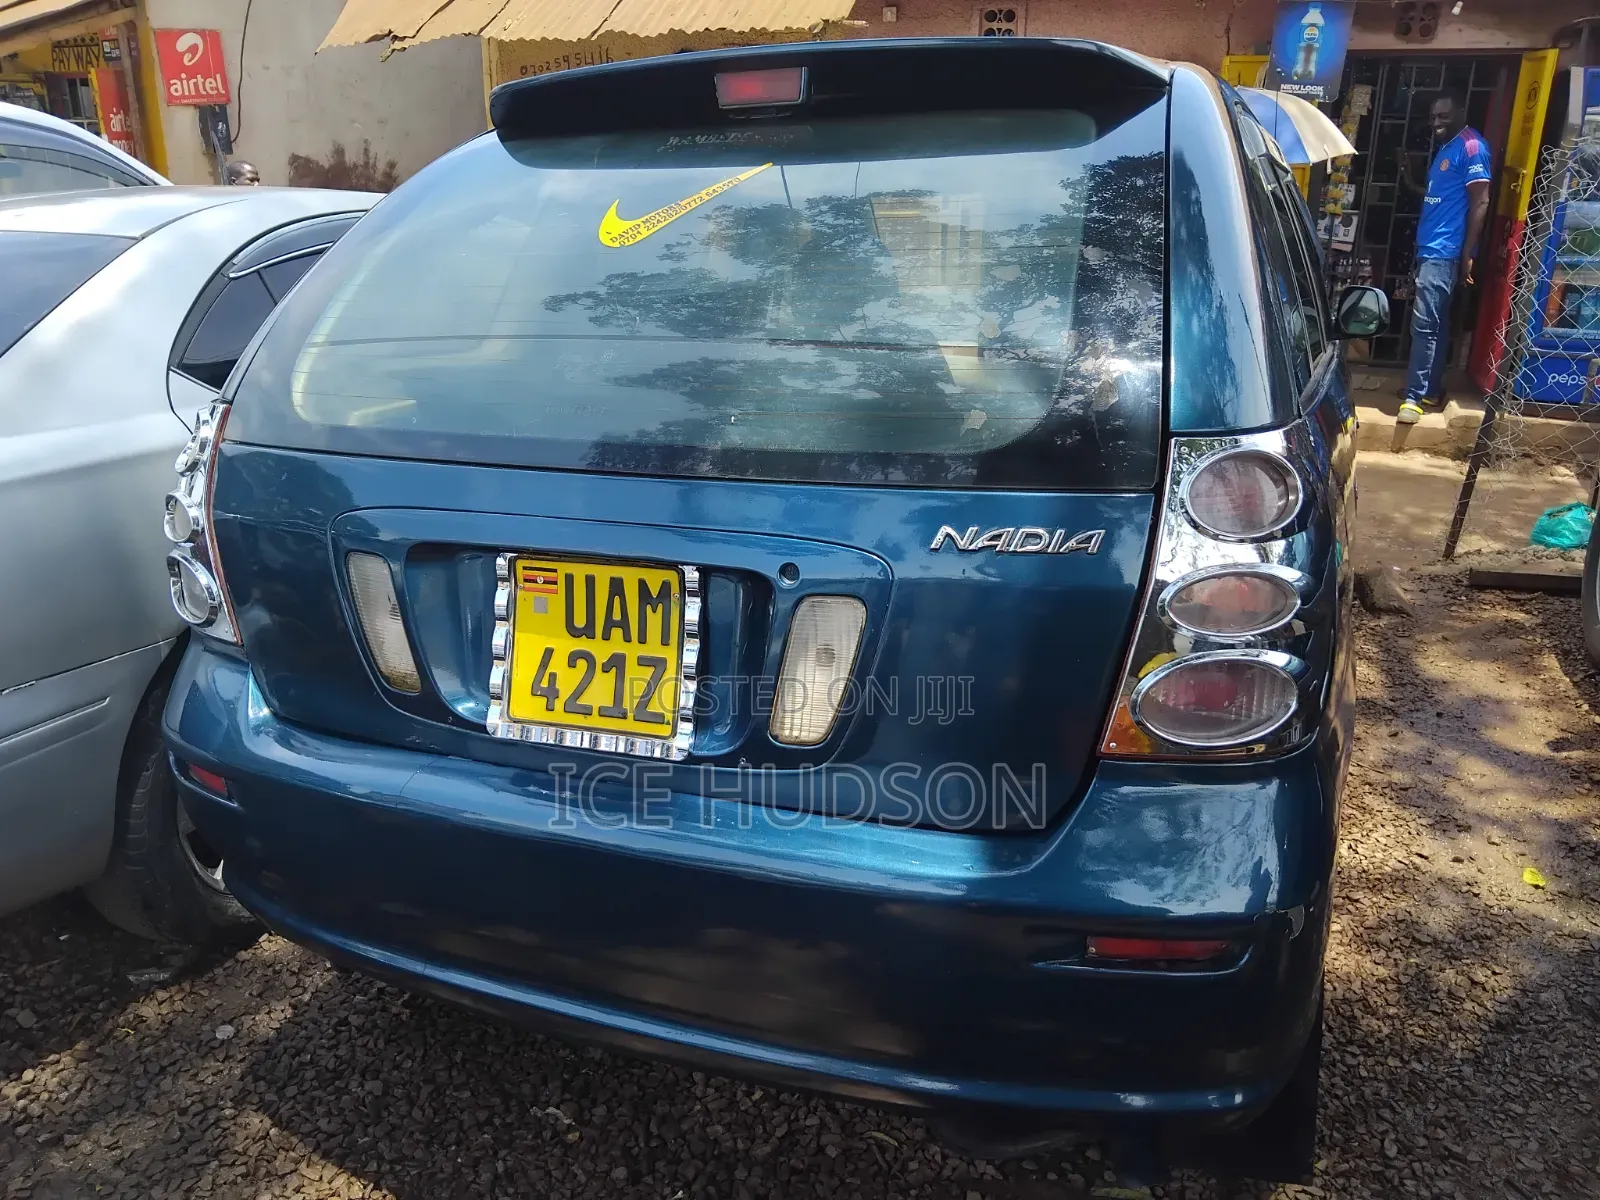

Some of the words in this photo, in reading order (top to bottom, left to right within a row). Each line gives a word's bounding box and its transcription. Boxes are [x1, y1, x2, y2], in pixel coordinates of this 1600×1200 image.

[169, 73, 226, 97] airtel
[1280, 83, 1300, 91] NEW
[1301, 84, 1324, 92] LOOK
[609, 222, 642, 244] DAVID
[642, 200, 683, 227] MOTORS
[618, 230, 644, 248] 0701
[929, 525, 1107, 555] NADIA
[564, 572, 672, 647] UAM
